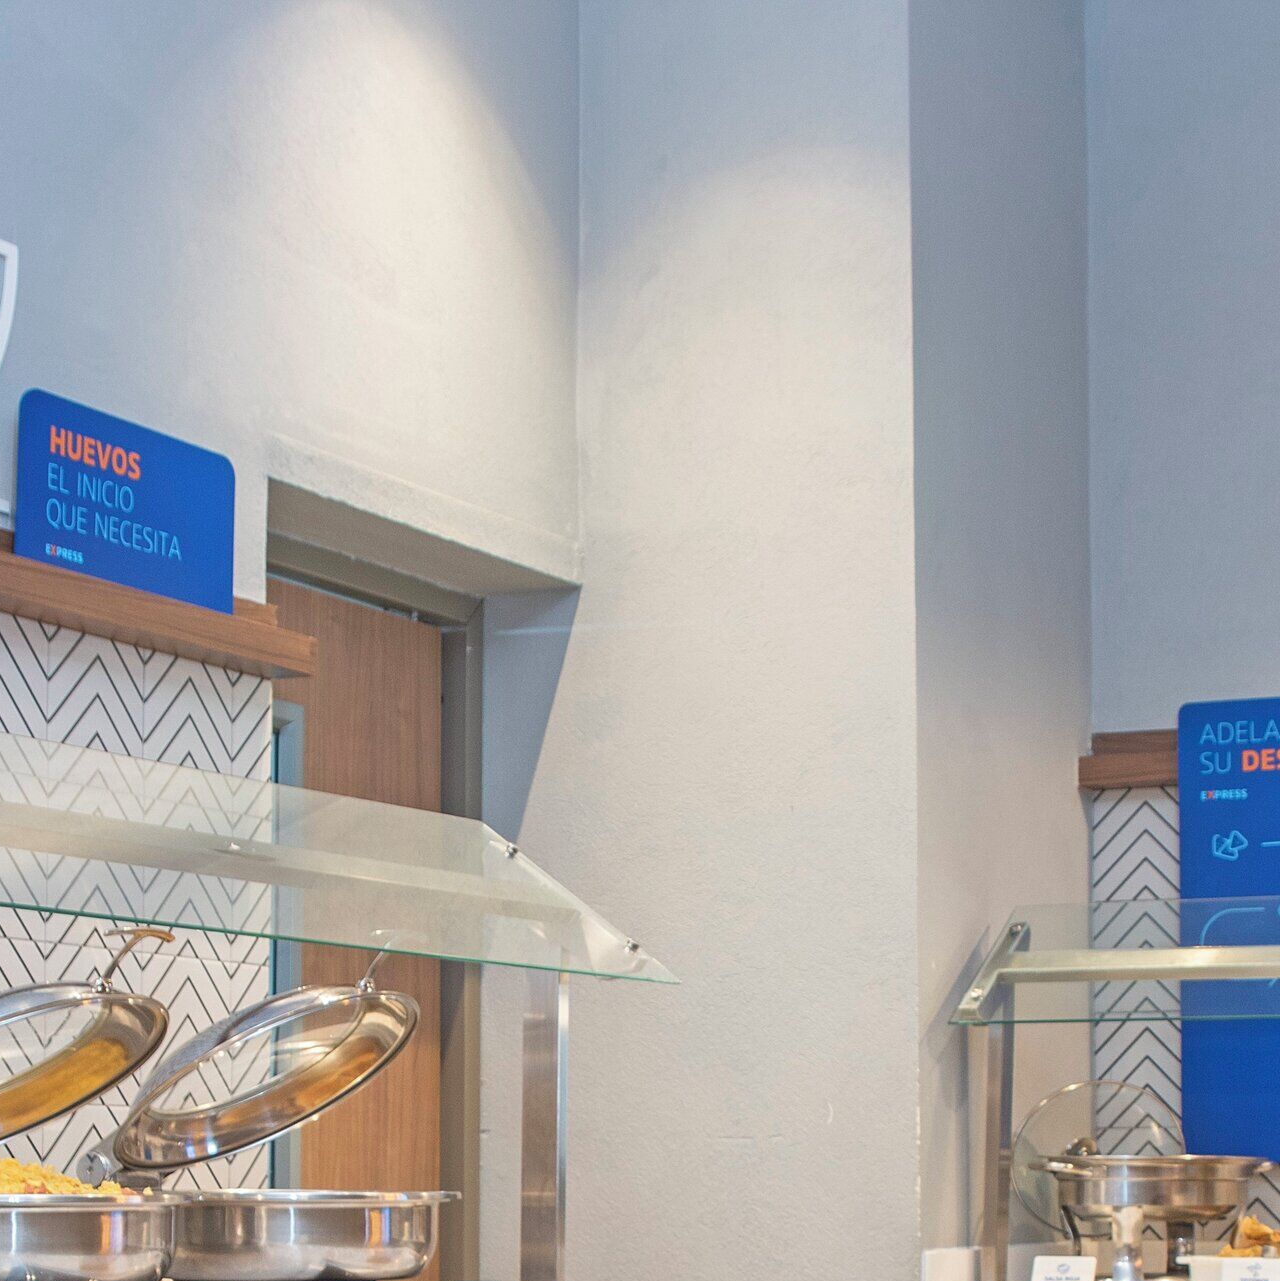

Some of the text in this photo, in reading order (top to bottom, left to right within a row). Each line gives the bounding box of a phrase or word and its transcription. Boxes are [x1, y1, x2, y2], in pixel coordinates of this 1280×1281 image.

[49, 424, 141, 480] HUEVOS
[47, 462, 135, 513] EL INICIO
[46, 498, 182, 561] QUE NECESITA
[45, 543, 84, 565] EXPRESS
[1199, 751, 1232, 776] SU
[1200, 788, 1249, 801] EXPRESS
